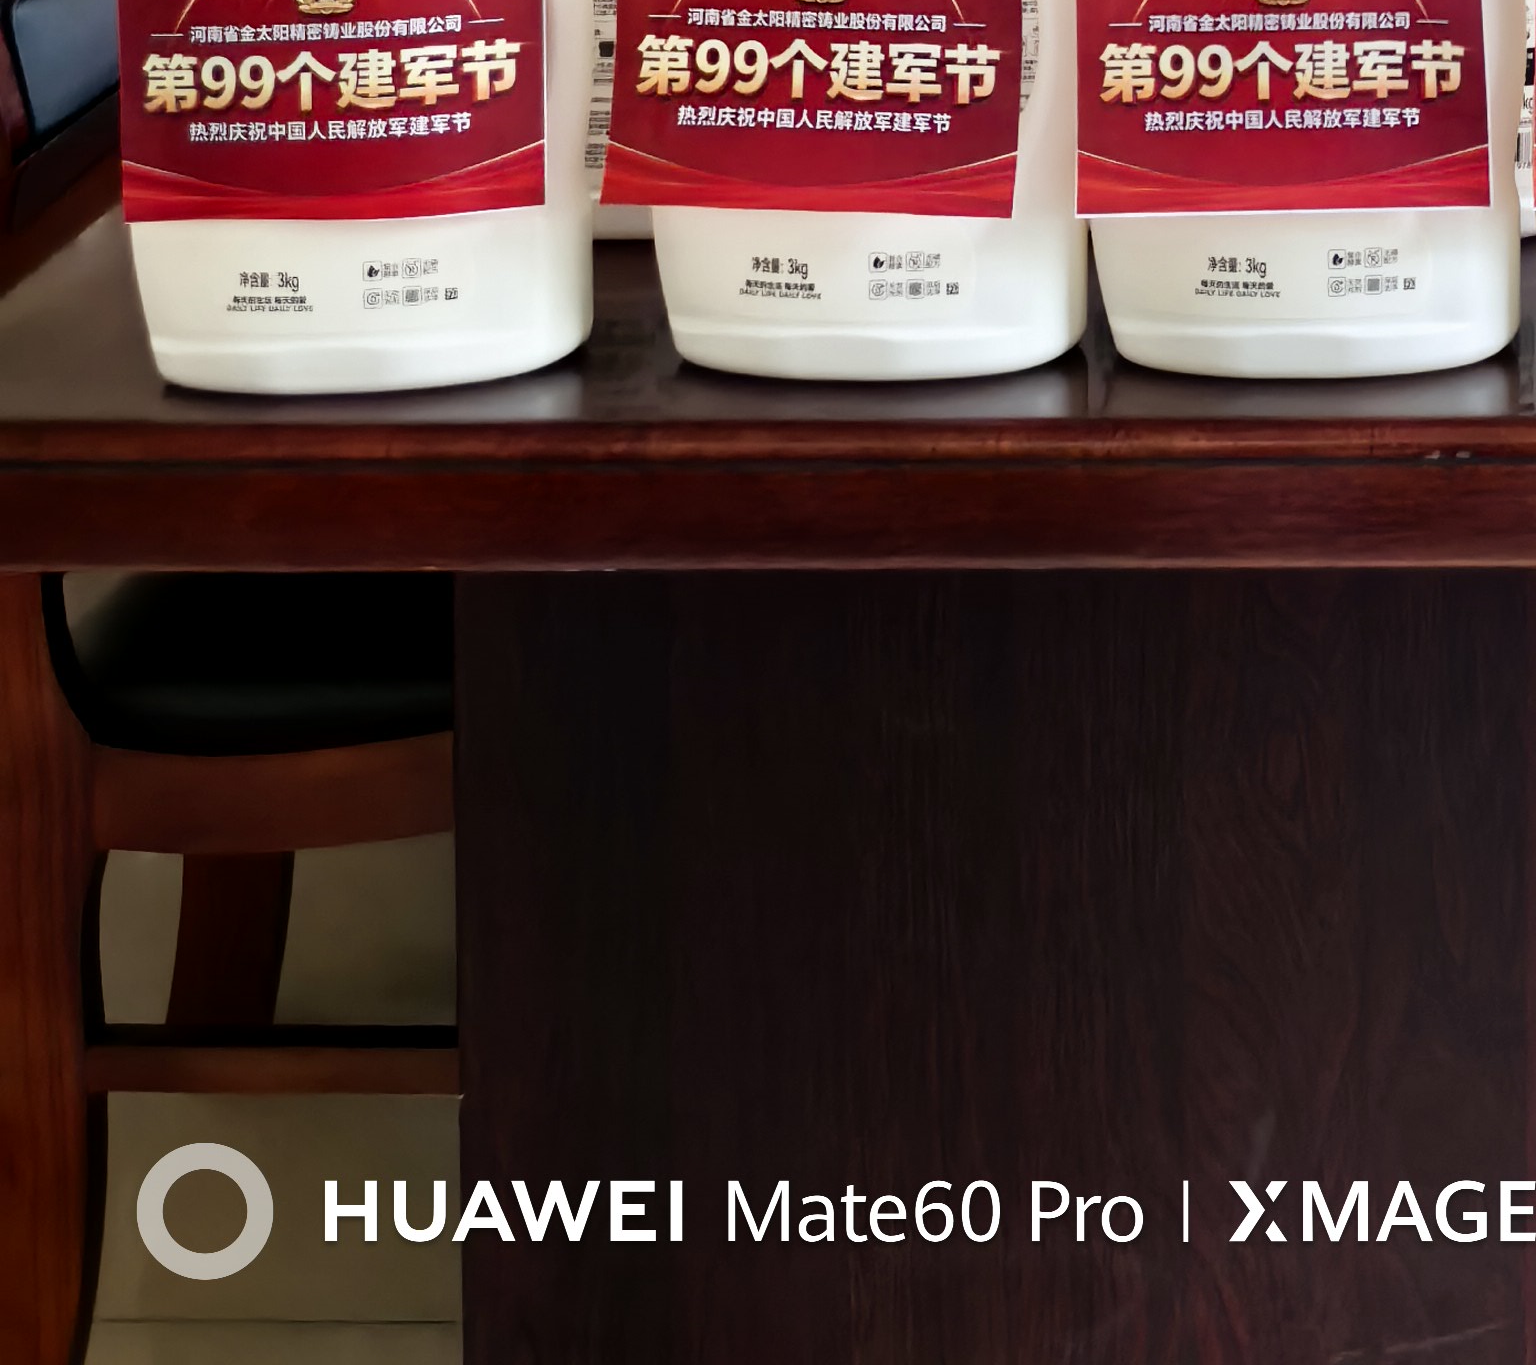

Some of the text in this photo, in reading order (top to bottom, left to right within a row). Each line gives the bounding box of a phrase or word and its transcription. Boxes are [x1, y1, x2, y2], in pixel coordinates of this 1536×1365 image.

[190, 14, 462, 43] 河南省金太阳精密铸业股份有限公司
[687, 7, 947, 33] 河南省金太阳精密铸业股份有限公司
[1148, 11, 1411, 33] 河南省金太阳精密铸业股份有限公司
[142, 38, 521, 113] 第99个建军节
[636, 34, 1001, 106] 第99个建军节
[1099, 40, 1464, 102] 第99个建军节
[189, 112, 472, 141] 热烈庆祝中国人民解放军建军节
[677, 105, 952, 134] 热烈庆祝中国人民解放军建军节
[1144, 107, 1420, 132] 热烈庆祝中国人民解放军建军节
[787, 257, 808, 279] 3kg
[1207, 256, 1267, 278] 净含量: 3kg
[277, 270, 300, 292] 3kg
